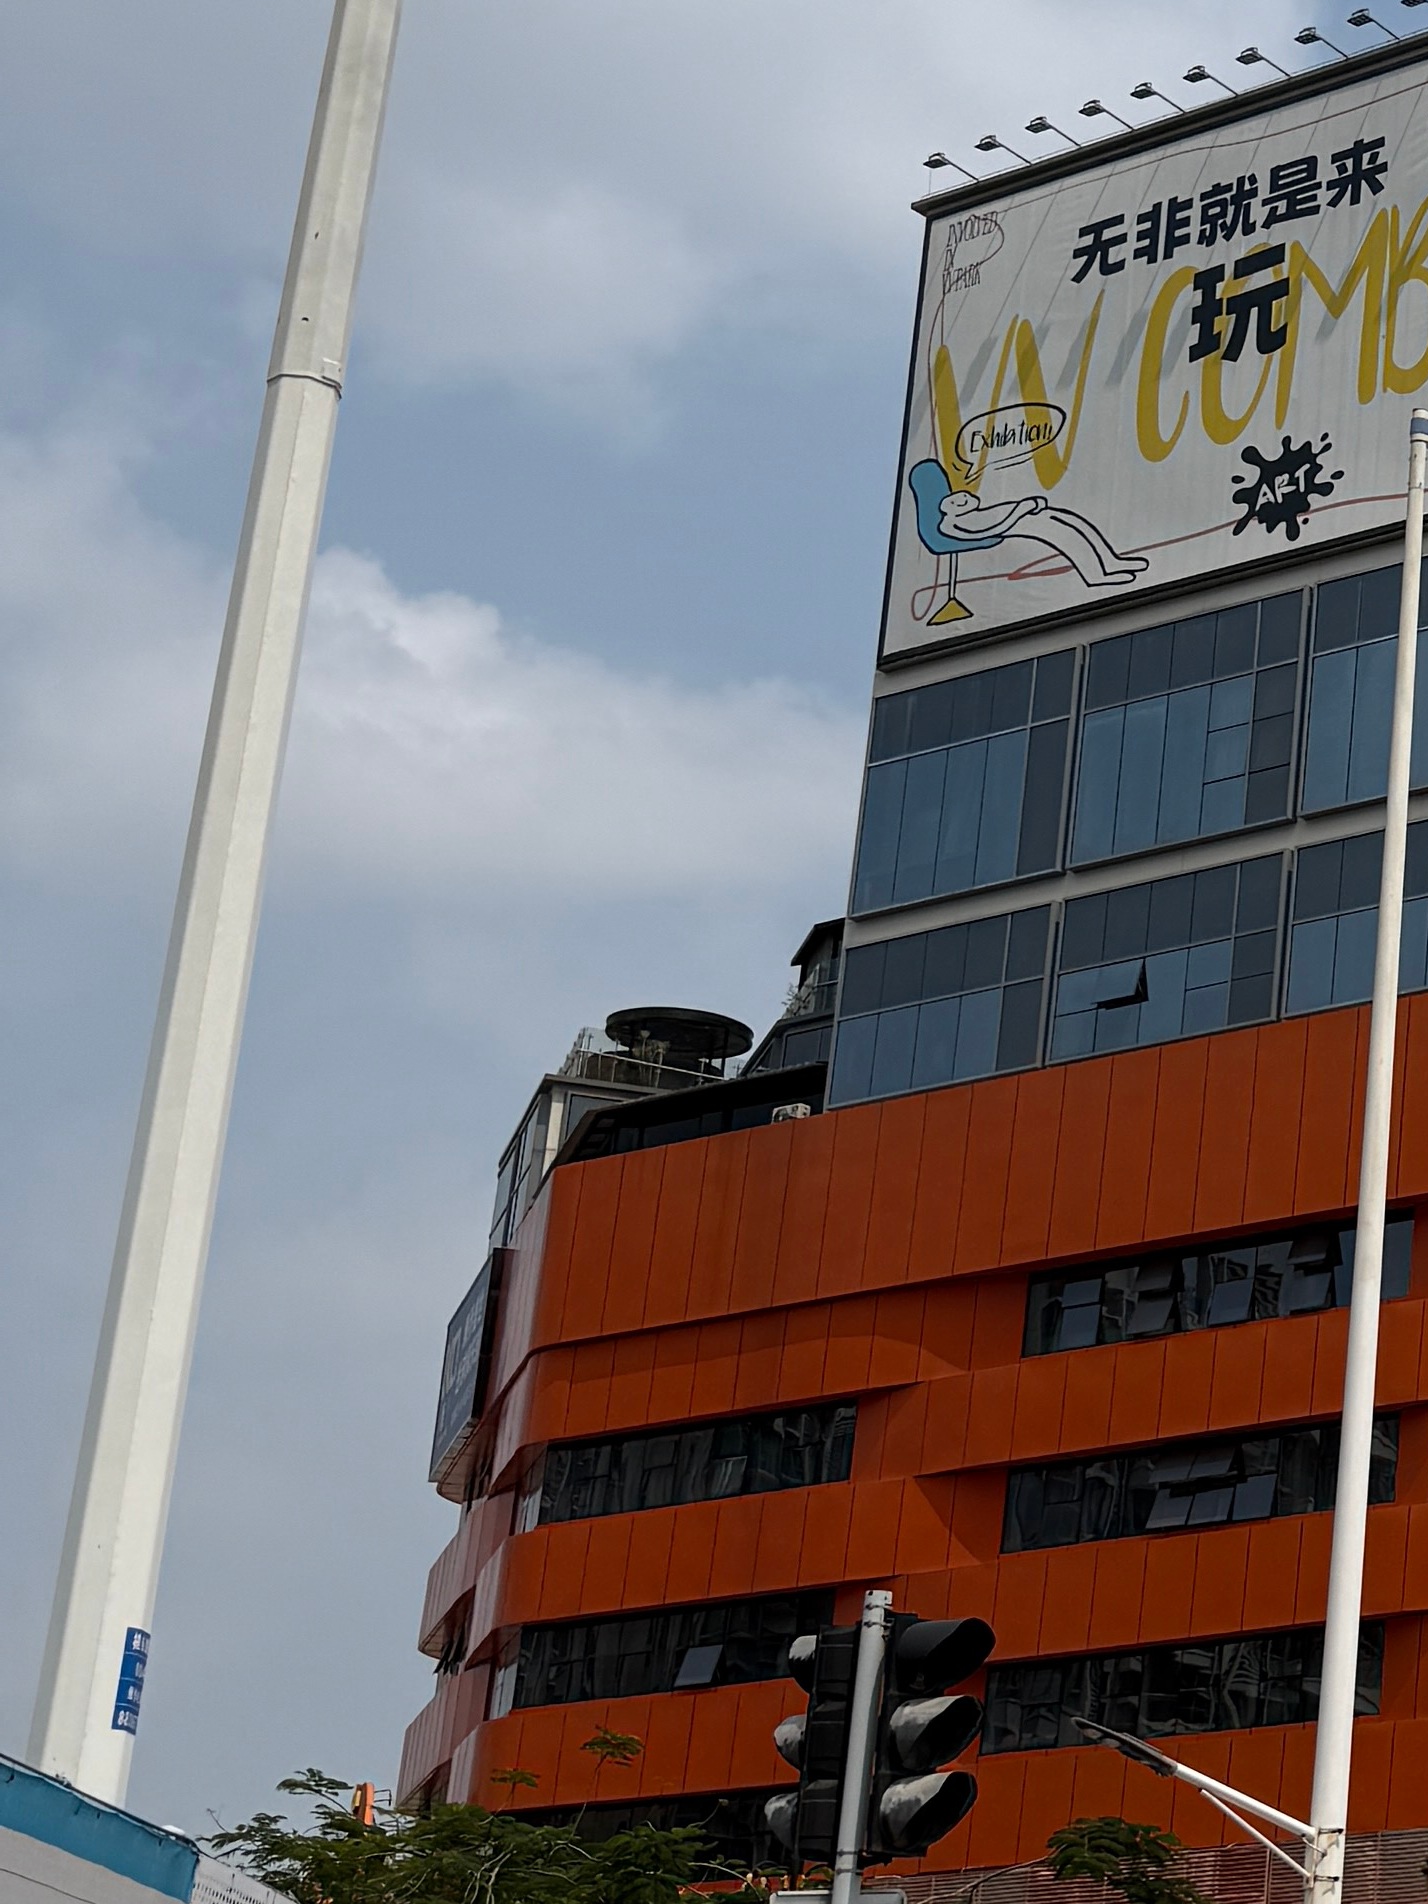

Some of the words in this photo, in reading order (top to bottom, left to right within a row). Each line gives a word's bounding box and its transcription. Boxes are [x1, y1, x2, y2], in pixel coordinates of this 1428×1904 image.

[1070, 136, 1388, 283] 无非就是来
[1188, 242, 1290, 363] 玩
[1256, 462, 1311, 511] ART
